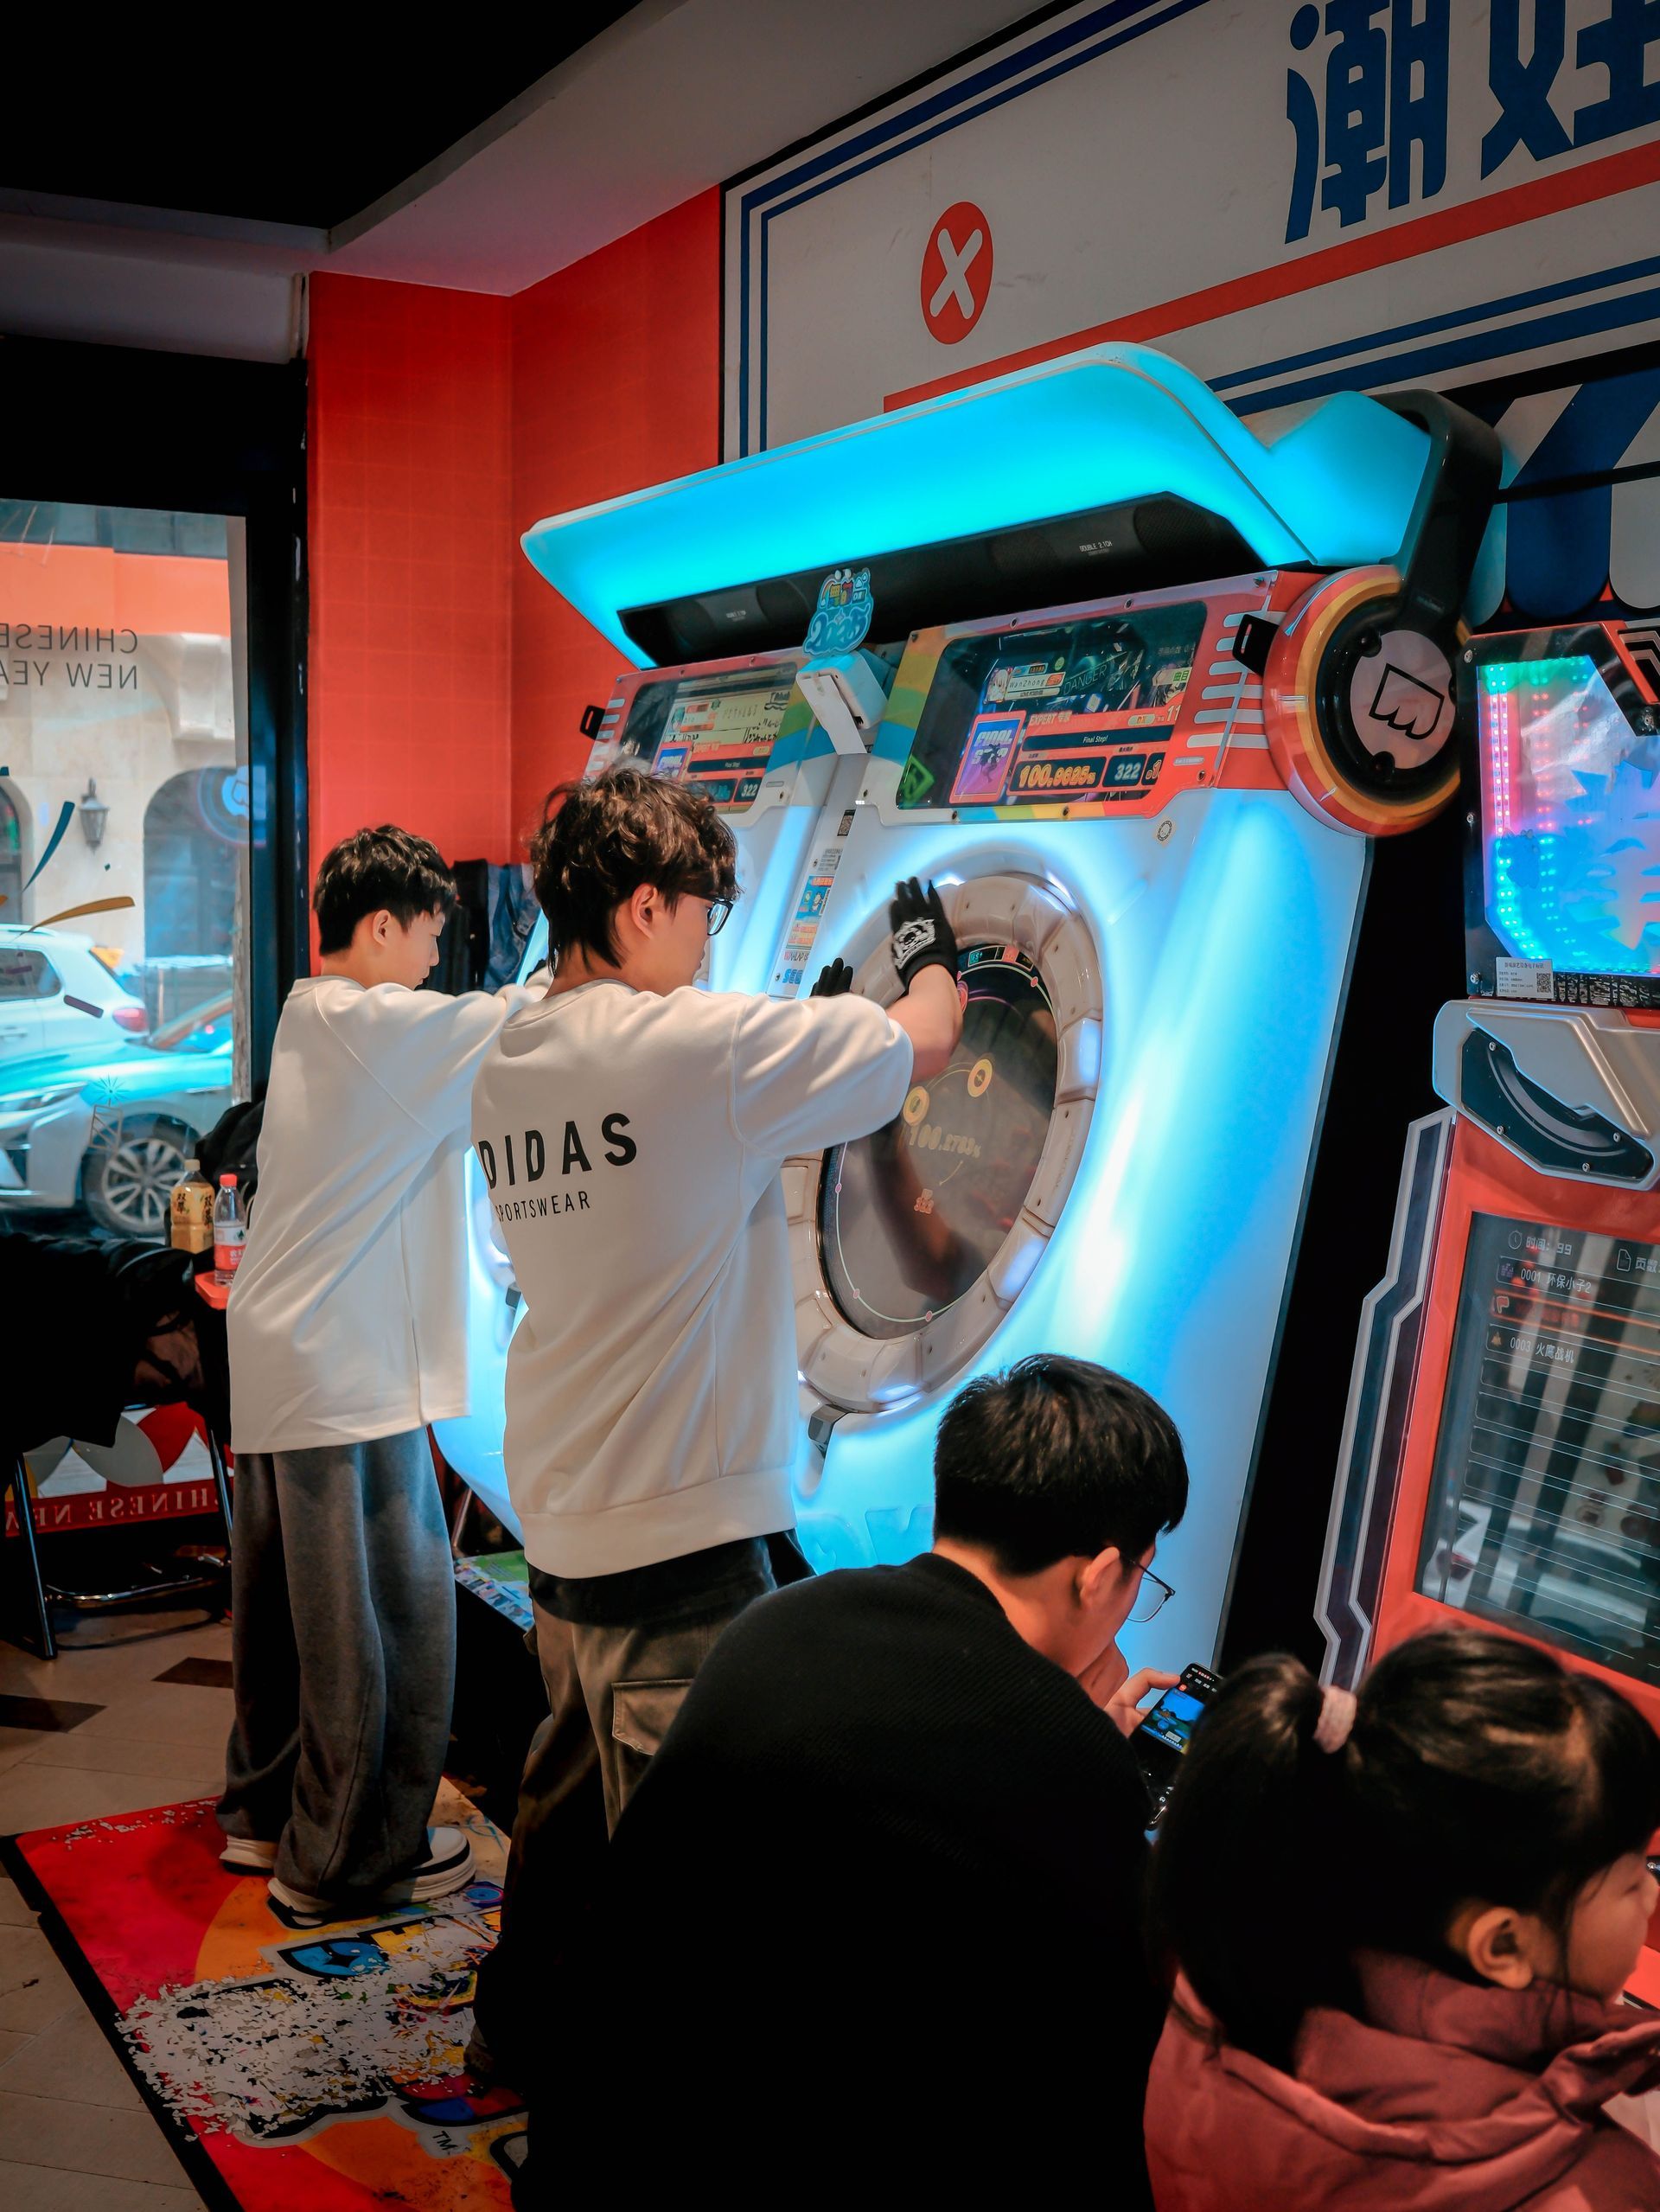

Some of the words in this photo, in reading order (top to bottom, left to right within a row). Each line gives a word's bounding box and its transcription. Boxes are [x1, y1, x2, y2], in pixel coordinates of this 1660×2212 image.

[1114, 762, 1142, 781] 322
[741, 783, 758, 796] 322
[782, 968, 804, 984] SEG
[478, 1112, 637, 1190] DIDAS
[495, 1191, 591, 1223] SPORTSWEAR
[1521, 1269, 1542, 1283] 0001
[1510, 1337, 1532, 1352] 0003
[432, 2130, 459, 2151] TM
